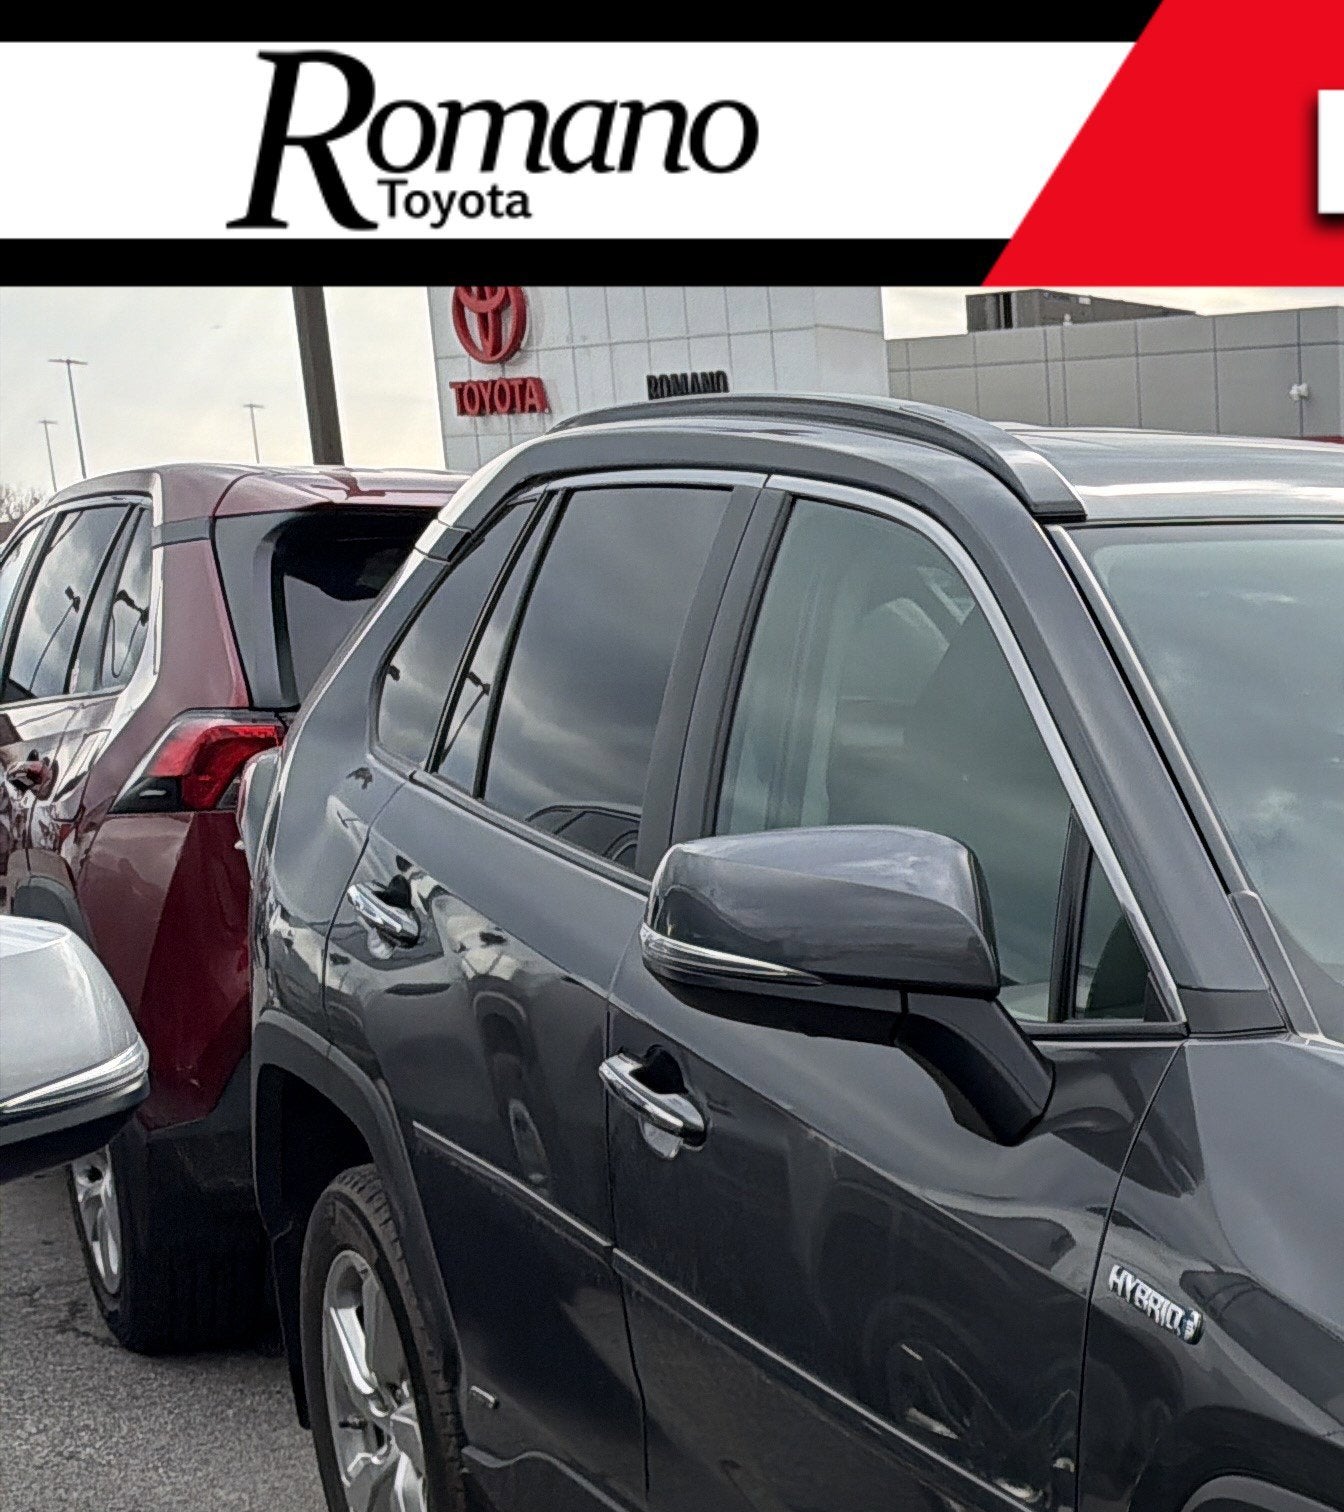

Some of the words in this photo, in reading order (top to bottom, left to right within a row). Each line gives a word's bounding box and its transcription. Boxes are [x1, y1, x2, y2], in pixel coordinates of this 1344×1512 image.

[449, 376, 549, 416] TOYOTA
[646, 370, 731, 400] ROMANO
[1108, 1264, 1184, 1336] HYBRID
